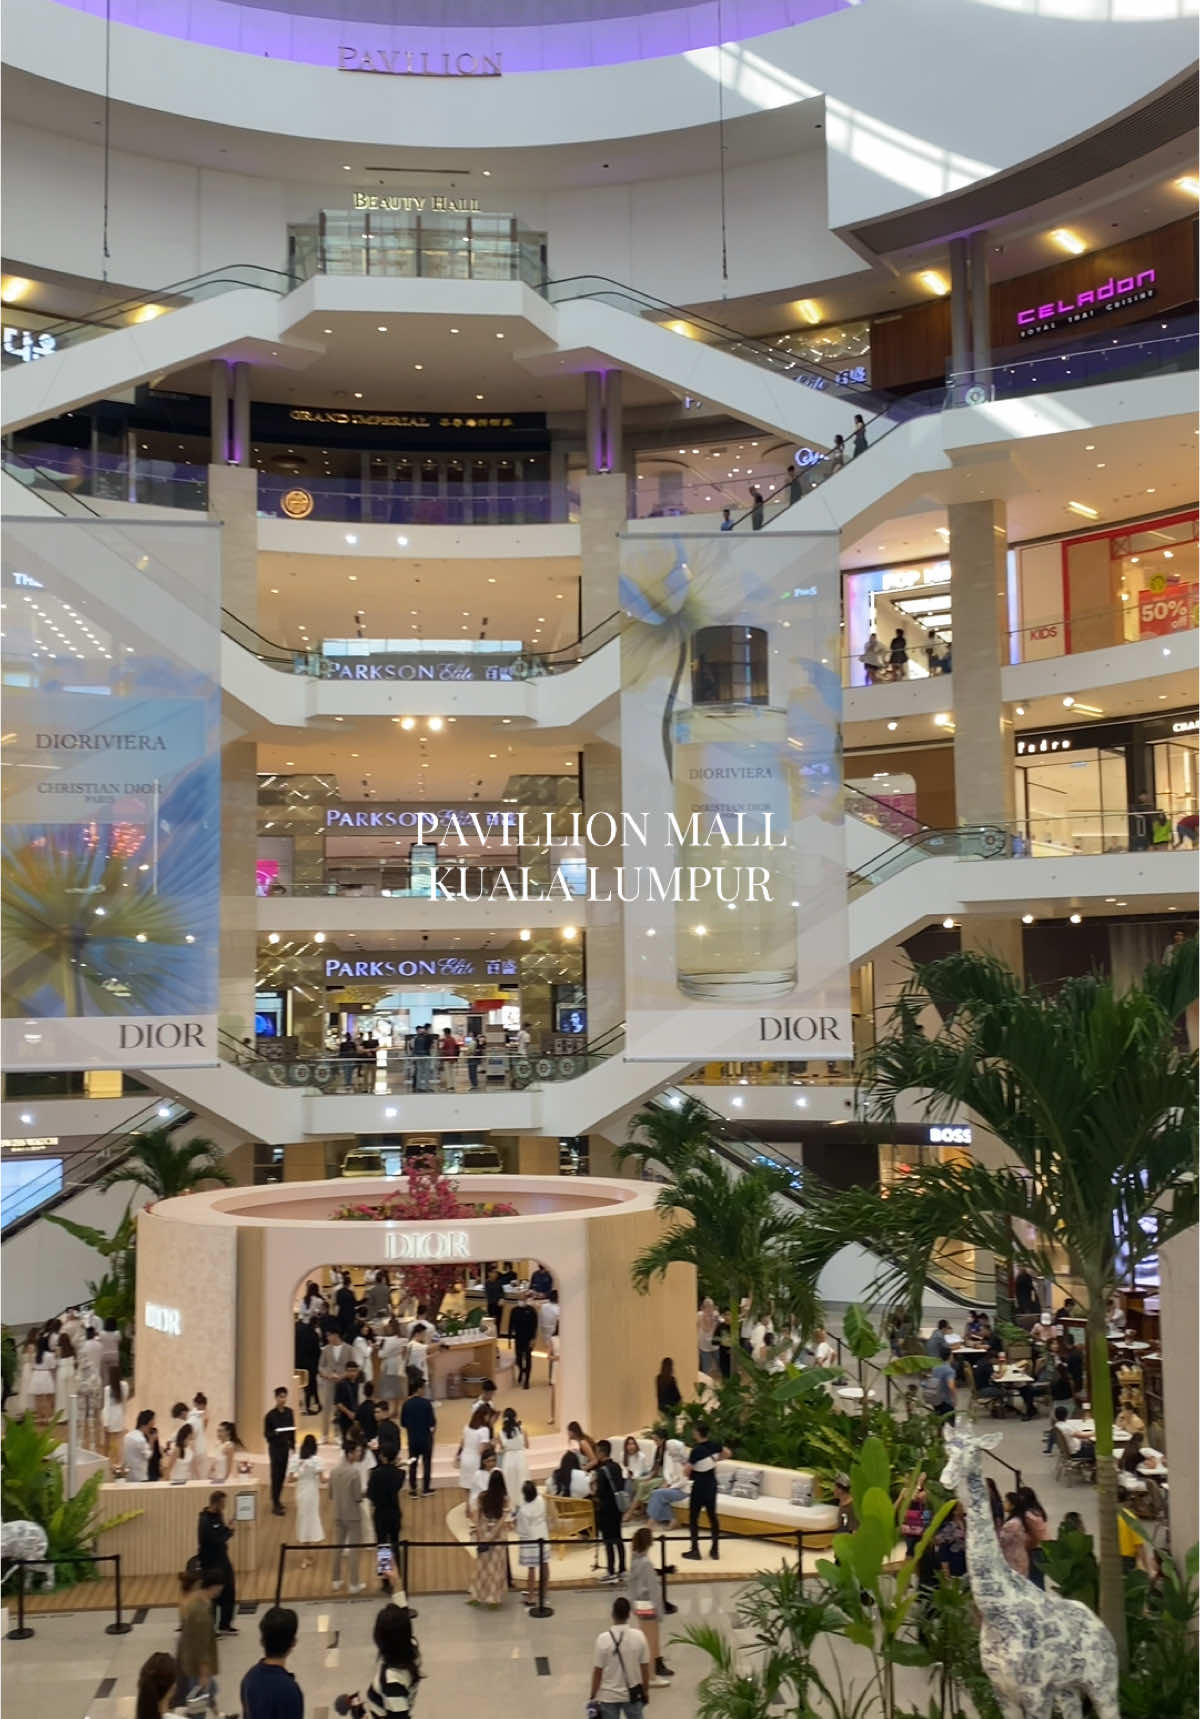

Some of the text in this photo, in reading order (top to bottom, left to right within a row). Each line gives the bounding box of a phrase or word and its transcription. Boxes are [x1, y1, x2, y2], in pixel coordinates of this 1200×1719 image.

[337, 46, 503, 76] PAVILION
[353, 192, 480, 212] BEAUTY HALL
[1141, 600, 1188, 623] 50%
[1030, 626, 1058, 641] KIDS
[328, 660, 434, 681] PARKSON
[36, 733, 168, 751] DIORIVIERA
[688, 766, 776, 780] DIORIVIERA
[37, 782, 121, 795] CHRISTIAN
[326, 809, 434, 827] PARKSON
[325, 959, 436, 977] PARKSON
[119, 1023, 207, 1048] DIOR
[759, 1016, 842, 1041] DIOR
[929, 1127, 972, 1144] BOSS
[385, 1230, 470, 1259] DIOR
[145, 1301, 182, 1337] DIOR
